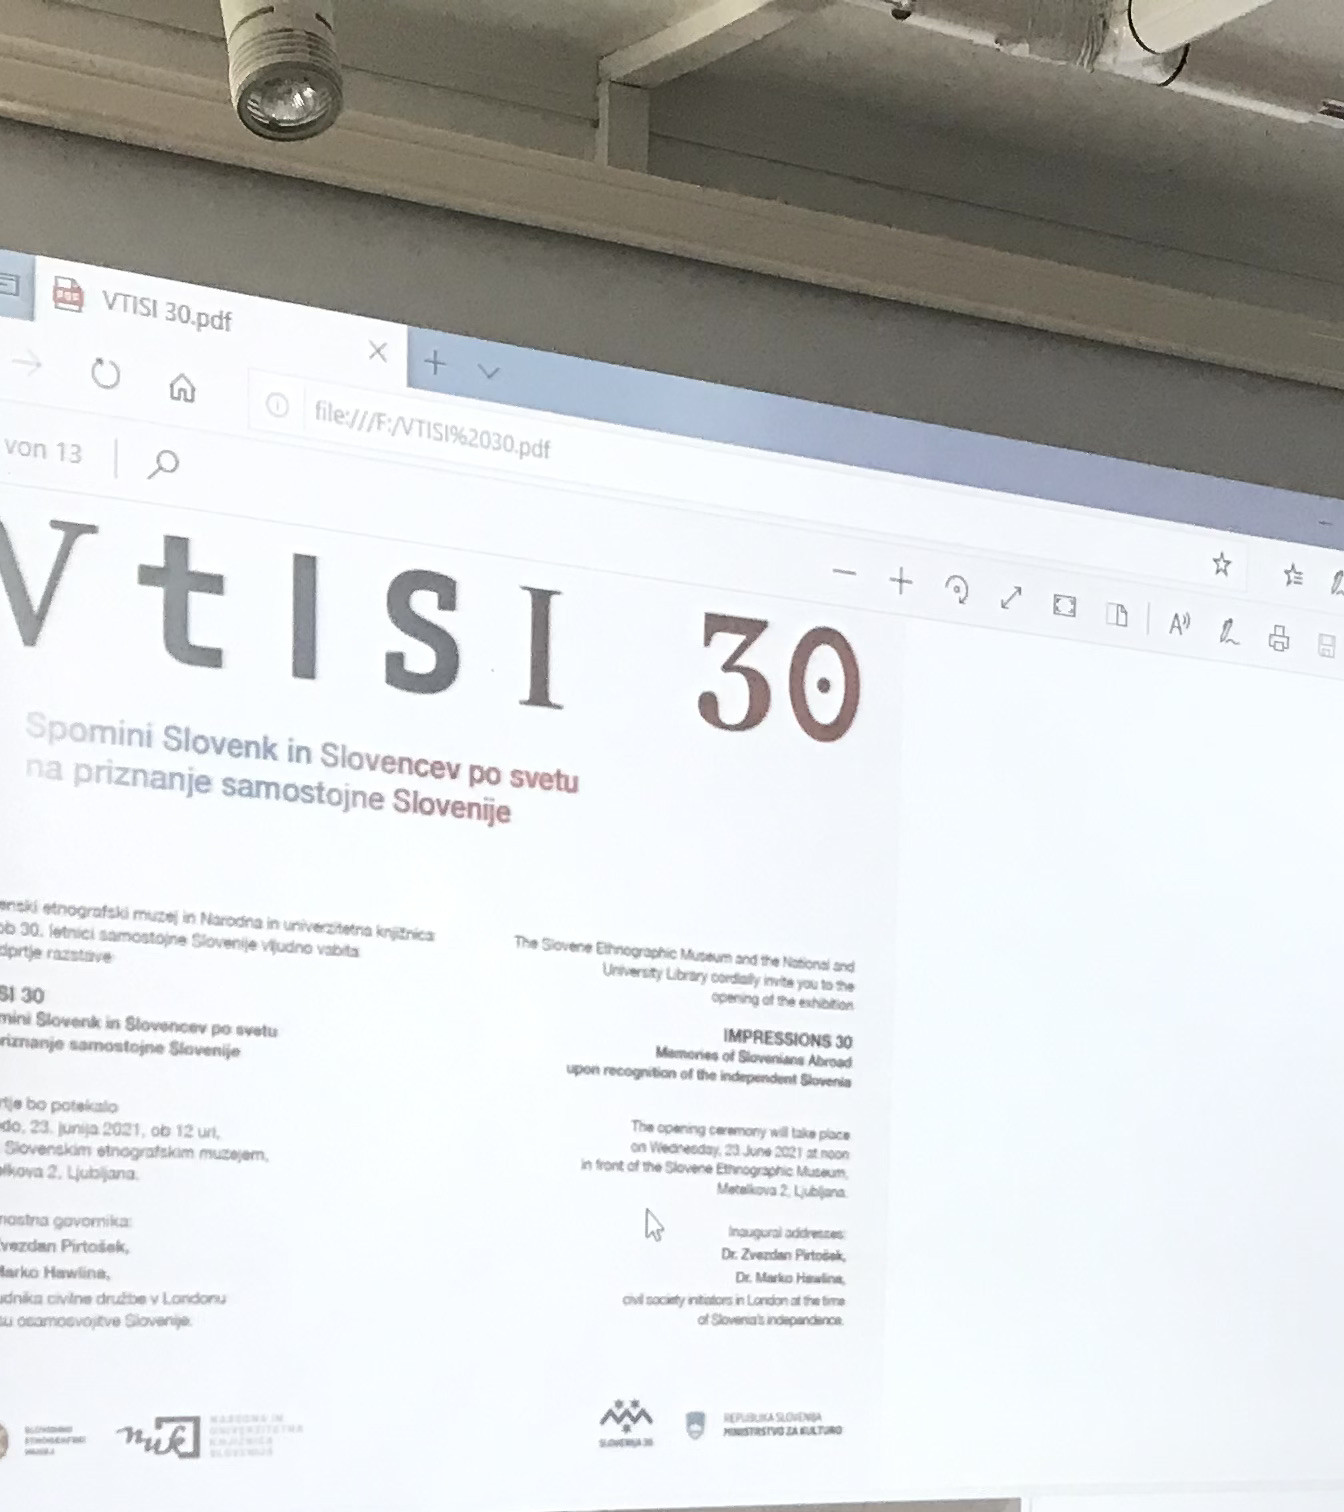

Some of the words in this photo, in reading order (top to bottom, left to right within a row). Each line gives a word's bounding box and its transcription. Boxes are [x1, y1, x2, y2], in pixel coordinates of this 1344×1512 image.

[102, 289, 158, 319] VTISI
[164, 302, 233, 333] 30.pdf
[4, 440, 48, 461] von
[56, 440, 83, 465] 13
[696, 611, 862, 744] 30
[26, 711, 153, 750] Spomini
[163, 725, 278, 762] Slovenk
[288, 737, 312, 765] in
[321, 741, 461, 781] Slovencev
[469, 763, 502, 789] po
[510, 768, 579, 795] svetu
[26, 756, 63, 781] na
[74, 759, 212, 799] priznanje
[221, 776, 385, 813] samostojne
[392, 787, 512, 829] Slovenije
[21, 986, 45, 1005] 30
[724, 1028, 832, 1049] IMPRESSIONS
[836, 1034, 853, 1050] 30
